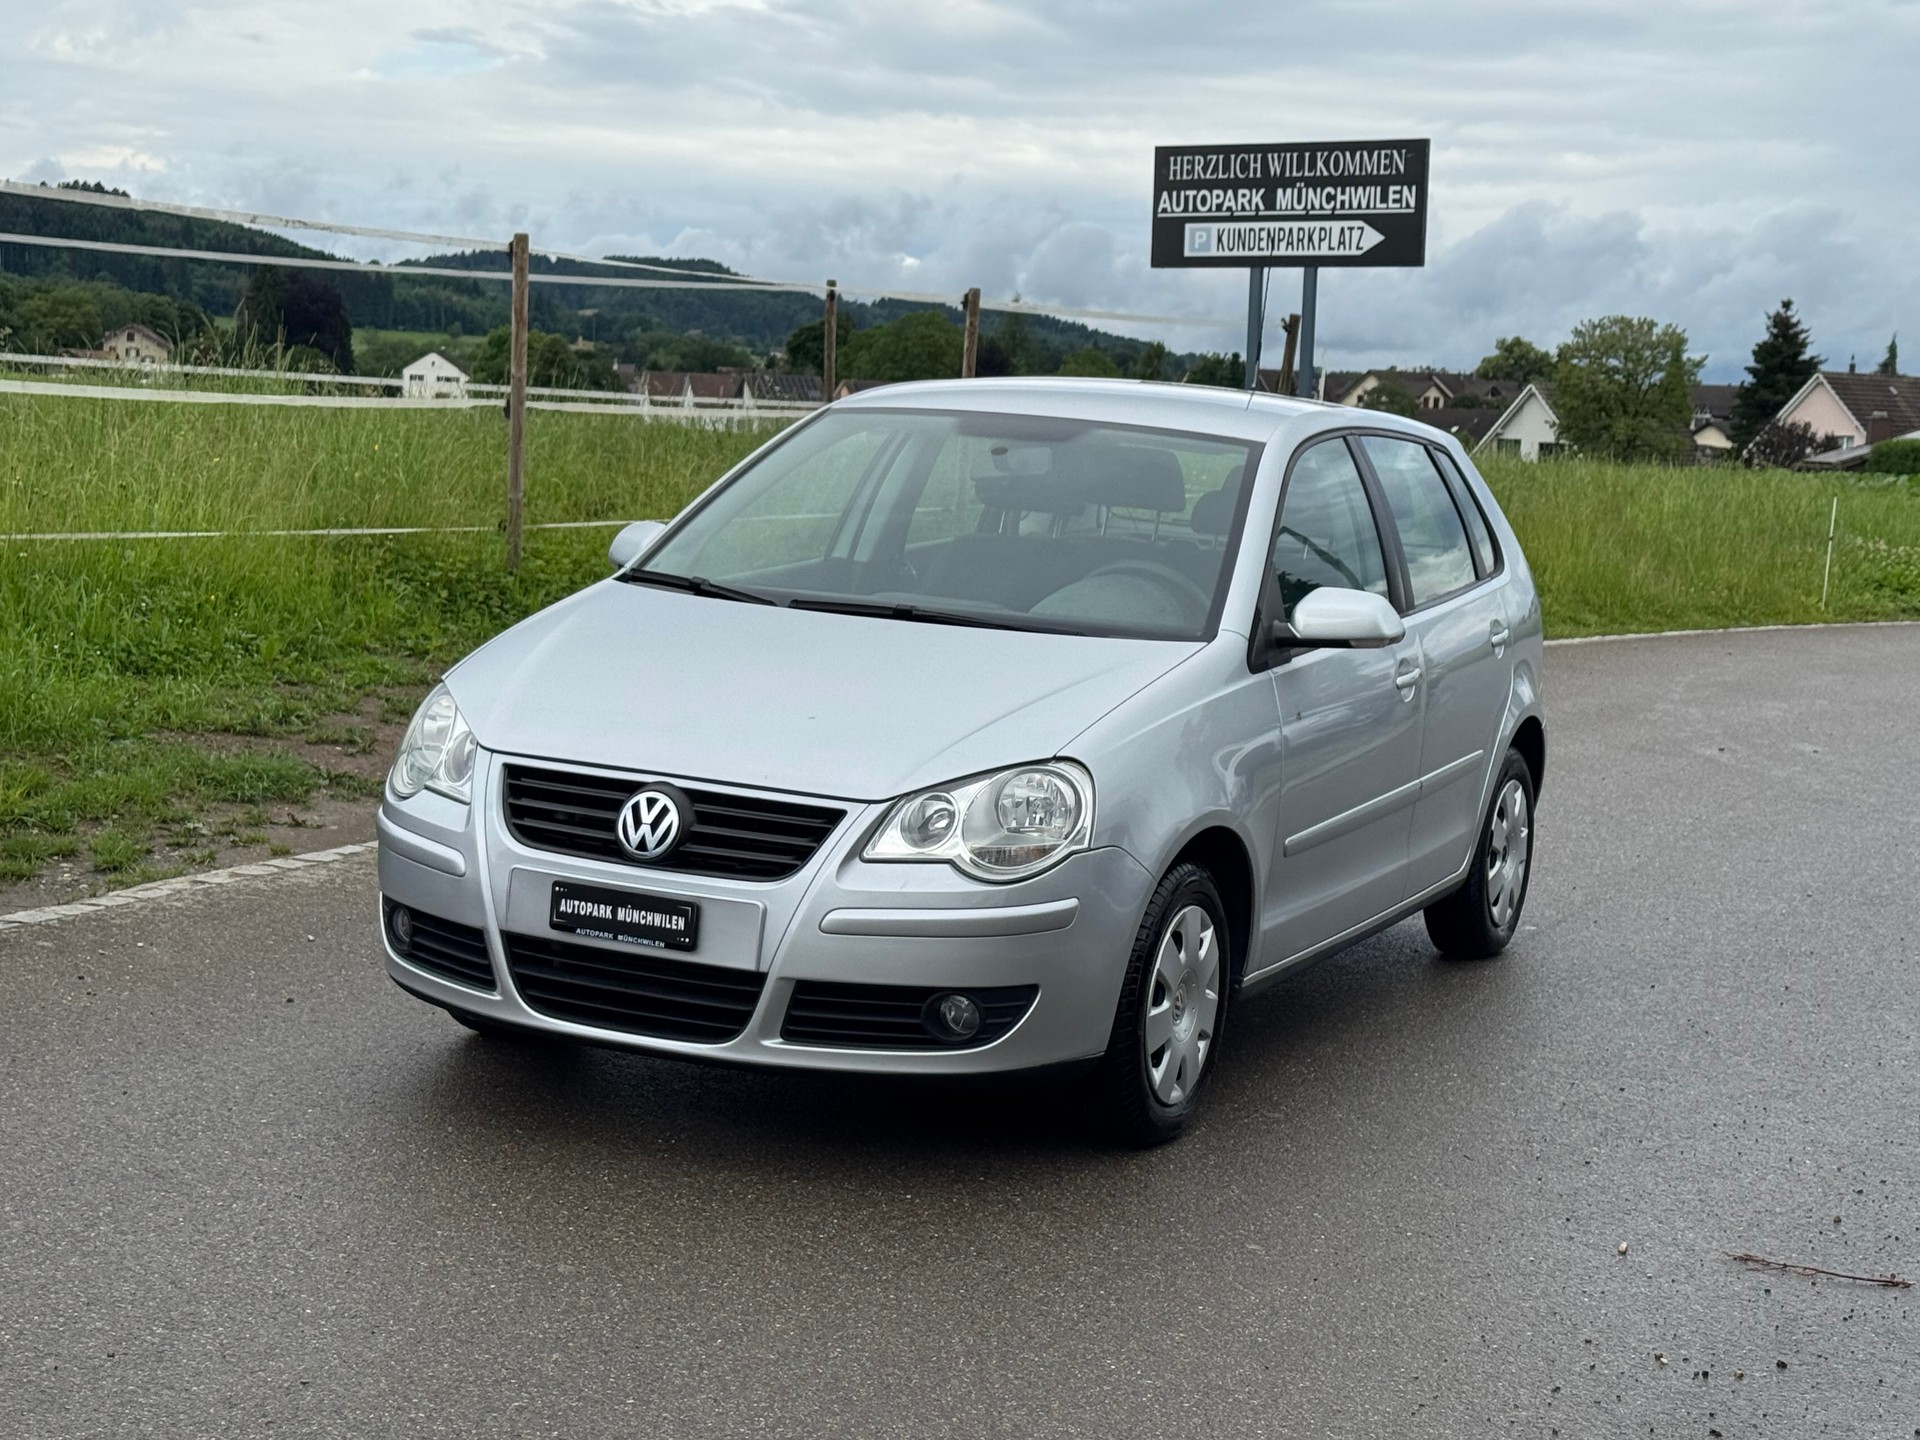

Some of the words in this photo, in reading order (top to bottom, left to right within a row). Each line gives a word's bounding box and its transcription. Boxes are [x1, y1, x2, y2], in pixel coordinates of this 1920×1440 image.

[1168, 152, 1262, 181] HERZLICH
[1267, 149, 1407, 178] WILLKOMMEN
[1158, 188, 1266, 213] AUTOPARK
[1276, 182, 1417, 211] MÜNCHWILEN
[1194, 230, 1207, 249] P
[1216, 225, 1365, 253] KUNDENPARKPLATZ
[618, 791, 679, 858] VW
[559, 898, 613, 920] AUTOPARK
[617, 904, 685, 931] MÜNCHWILEN
[575, 927, 614, 940] AUTOPARK
[617, 934, 666, 949] MÜNCHWILEN
